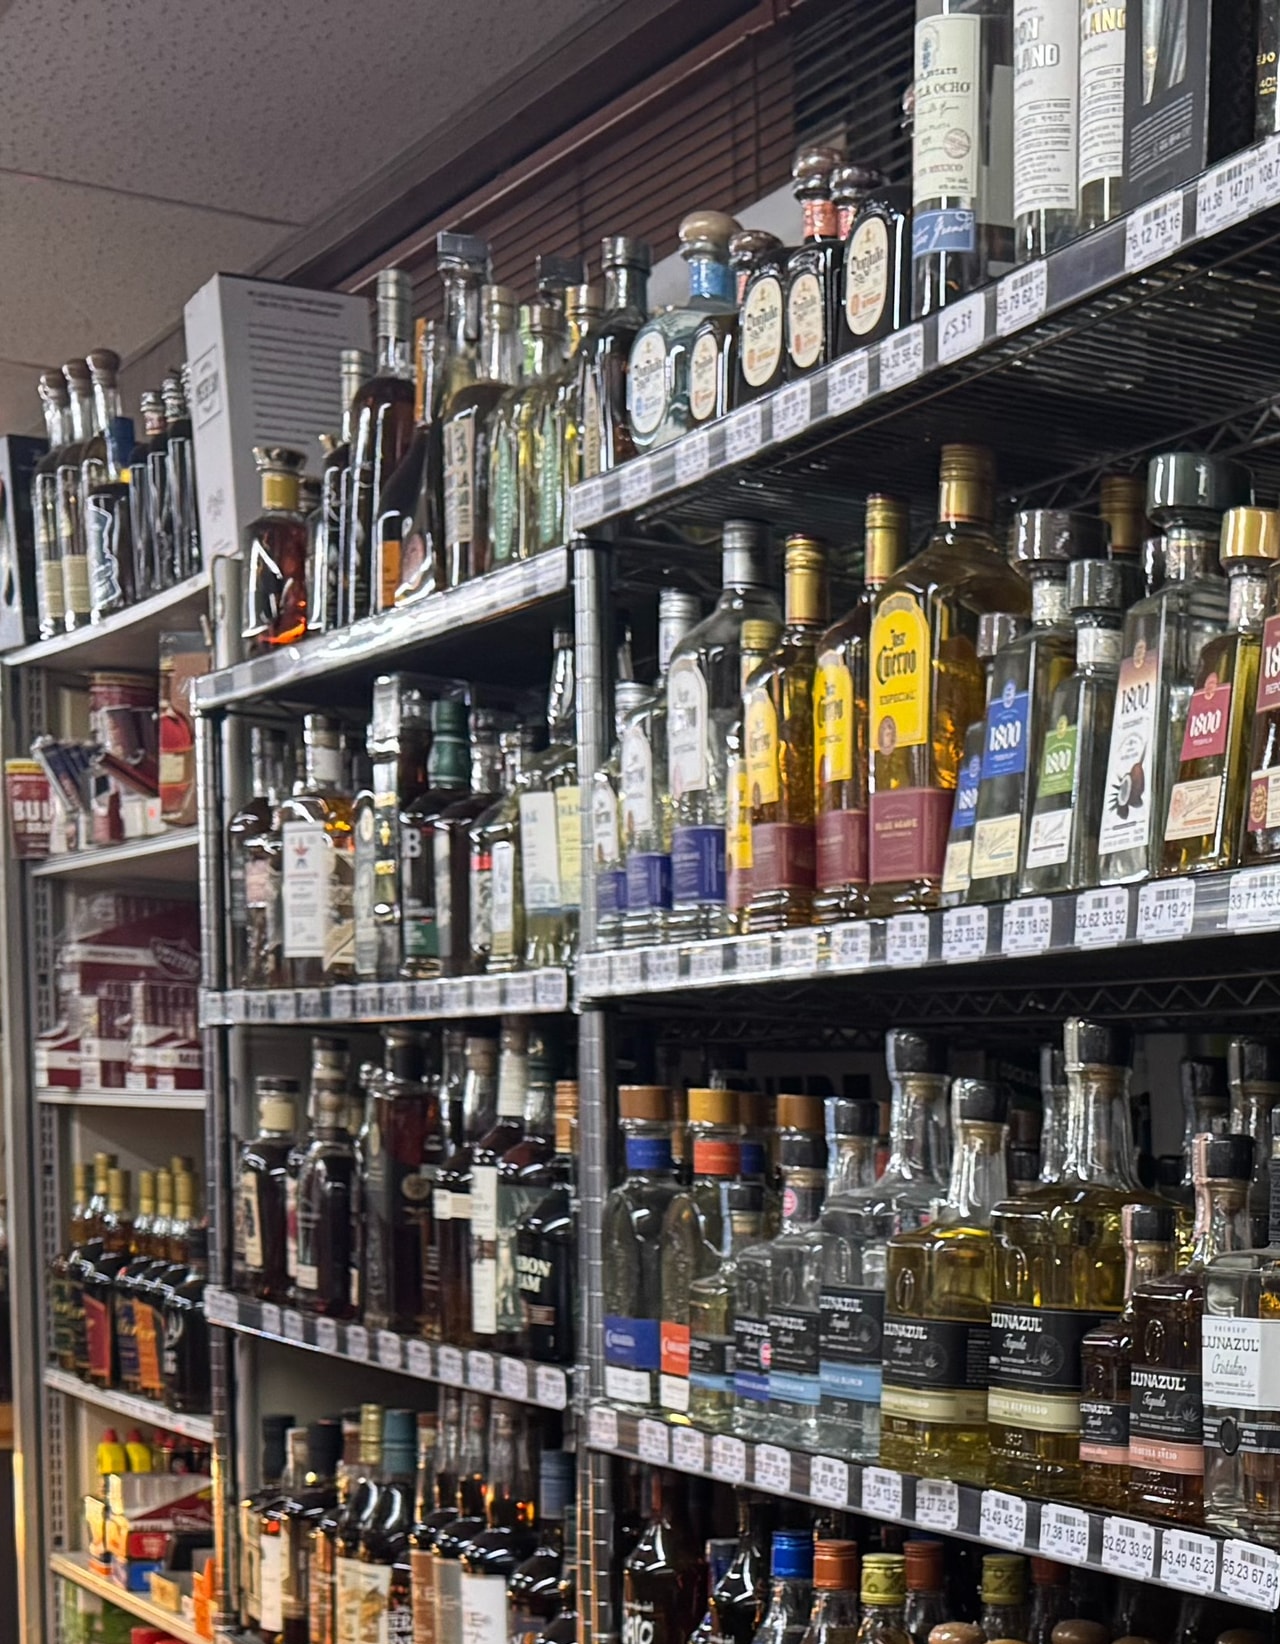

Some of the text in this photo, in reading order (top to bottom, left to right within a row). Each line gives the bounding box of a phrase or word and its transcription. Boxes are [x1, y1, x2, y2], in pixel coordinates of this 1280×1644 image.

[1189, 709, 1221, 736] 1800
[1139, 901, 1194, 921] 18.47 19.21
[991, 1313, 1042, 1334] LUNAZUL
[1131, 1372, 1184, 1391] LUNAZUL
[1162, 1549, 1214, 1575] 43.49 45.23
[1223, 1558, 1278, 1590] 65.23 67.84
